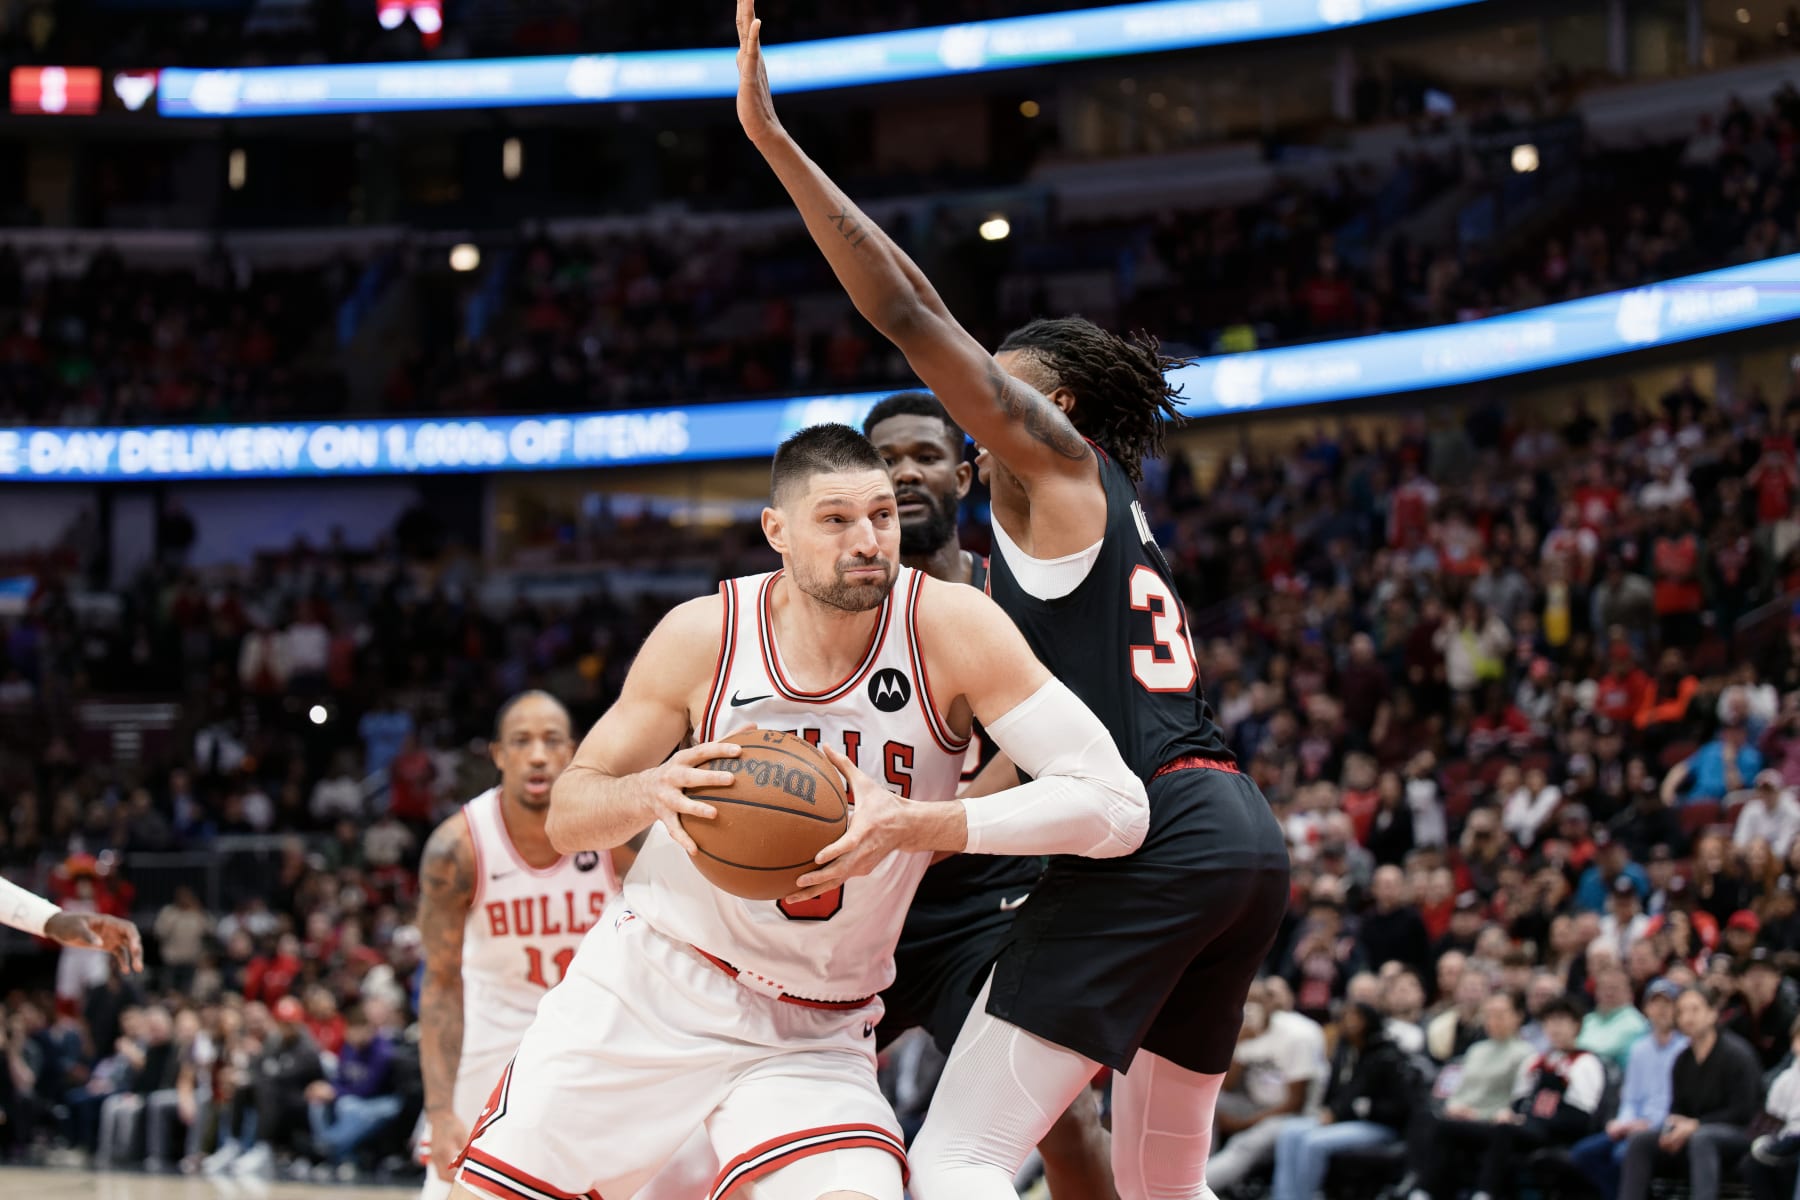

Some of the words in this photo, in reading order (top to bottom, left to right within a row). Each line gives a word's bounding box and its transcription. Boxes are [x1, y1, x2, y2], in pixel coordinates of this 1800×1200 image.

[118, 428, 307, 473] DELIVERY
[308, 425, 379, 468] ON
[509, 419, 572, 465] OF
[573, 411, 690, 461] ITEMS
[486, 888, 606, 937] BULLS
